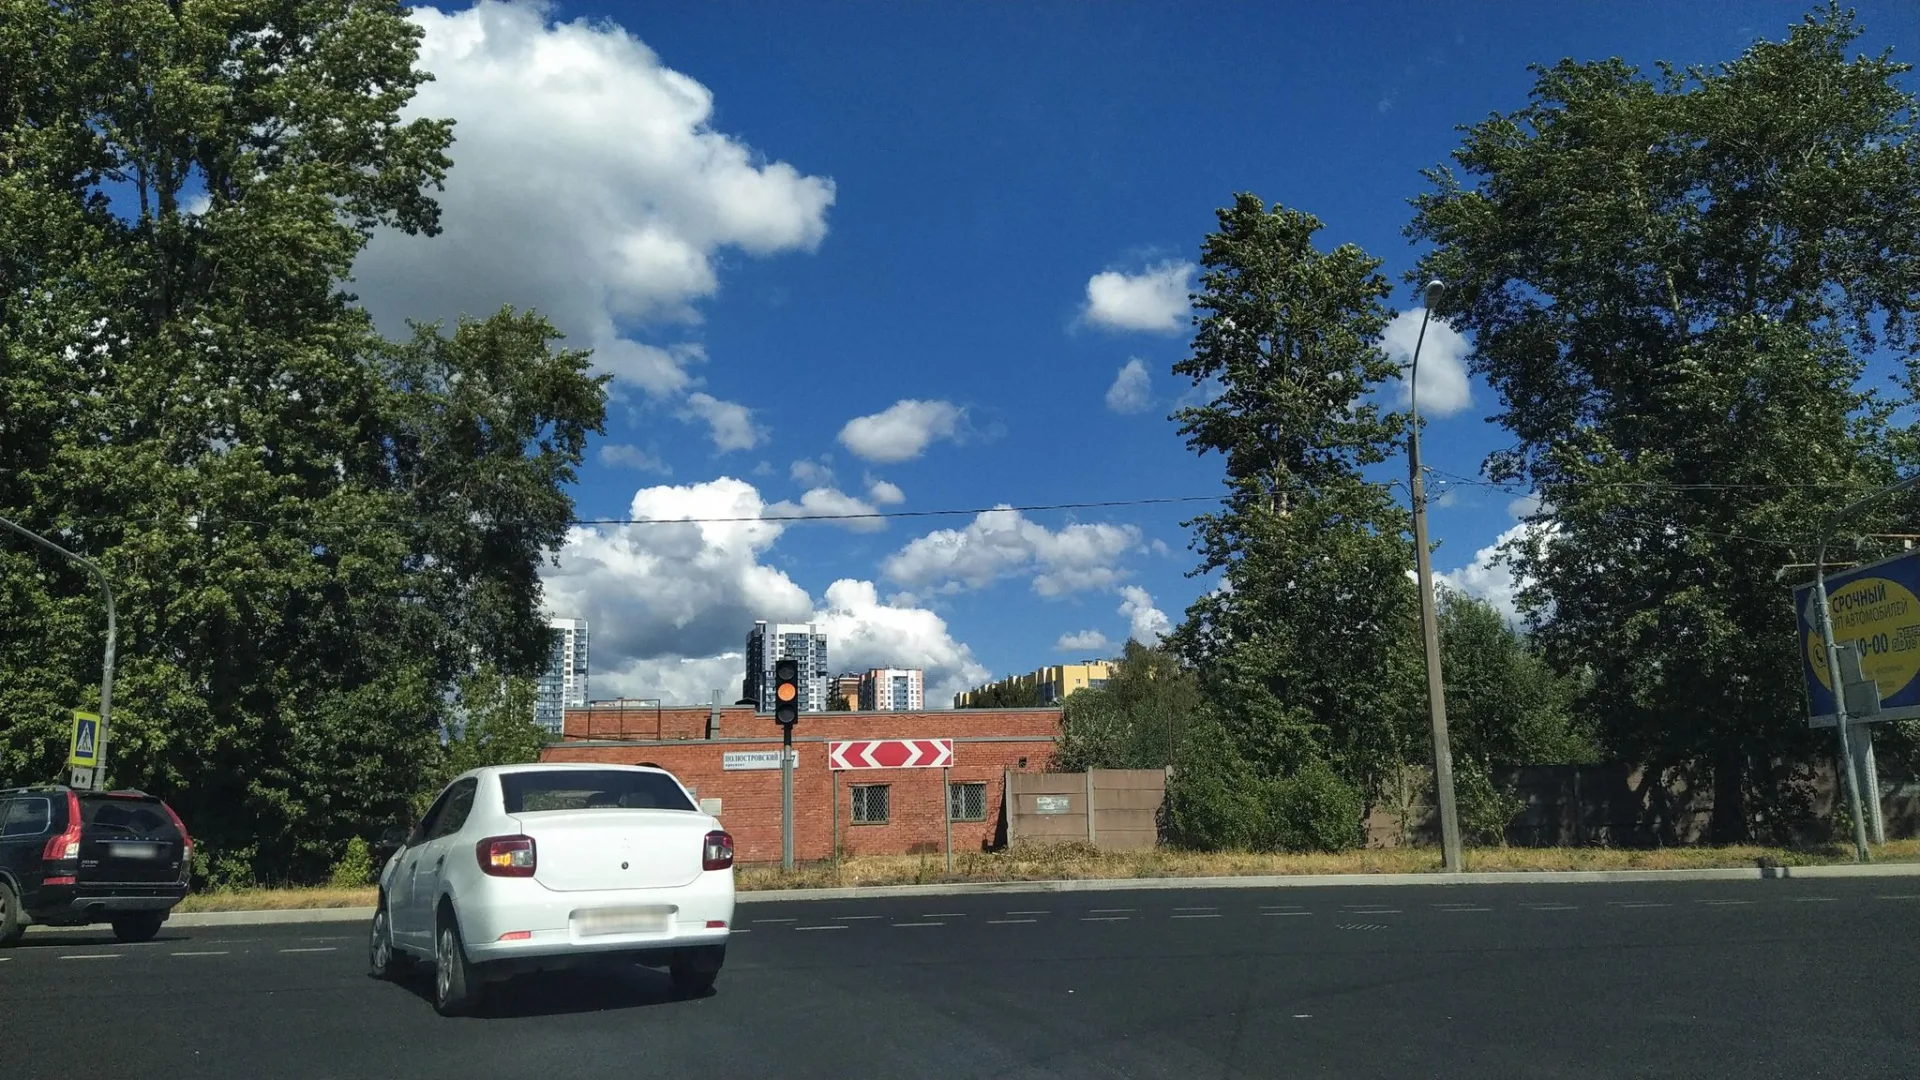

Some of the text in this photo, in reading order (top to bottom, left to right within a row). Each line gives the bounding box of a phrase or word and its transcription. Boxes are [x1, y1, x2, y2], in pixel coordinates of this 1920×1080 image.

[1832, 582, 1886, 613] СРОЧНЫЙ
[1845, 598, 1909, 628] АВТОМОБИЛЕЙ
[725, 753, 778, 762] ПОЛЮСТРОВСКИЙ
